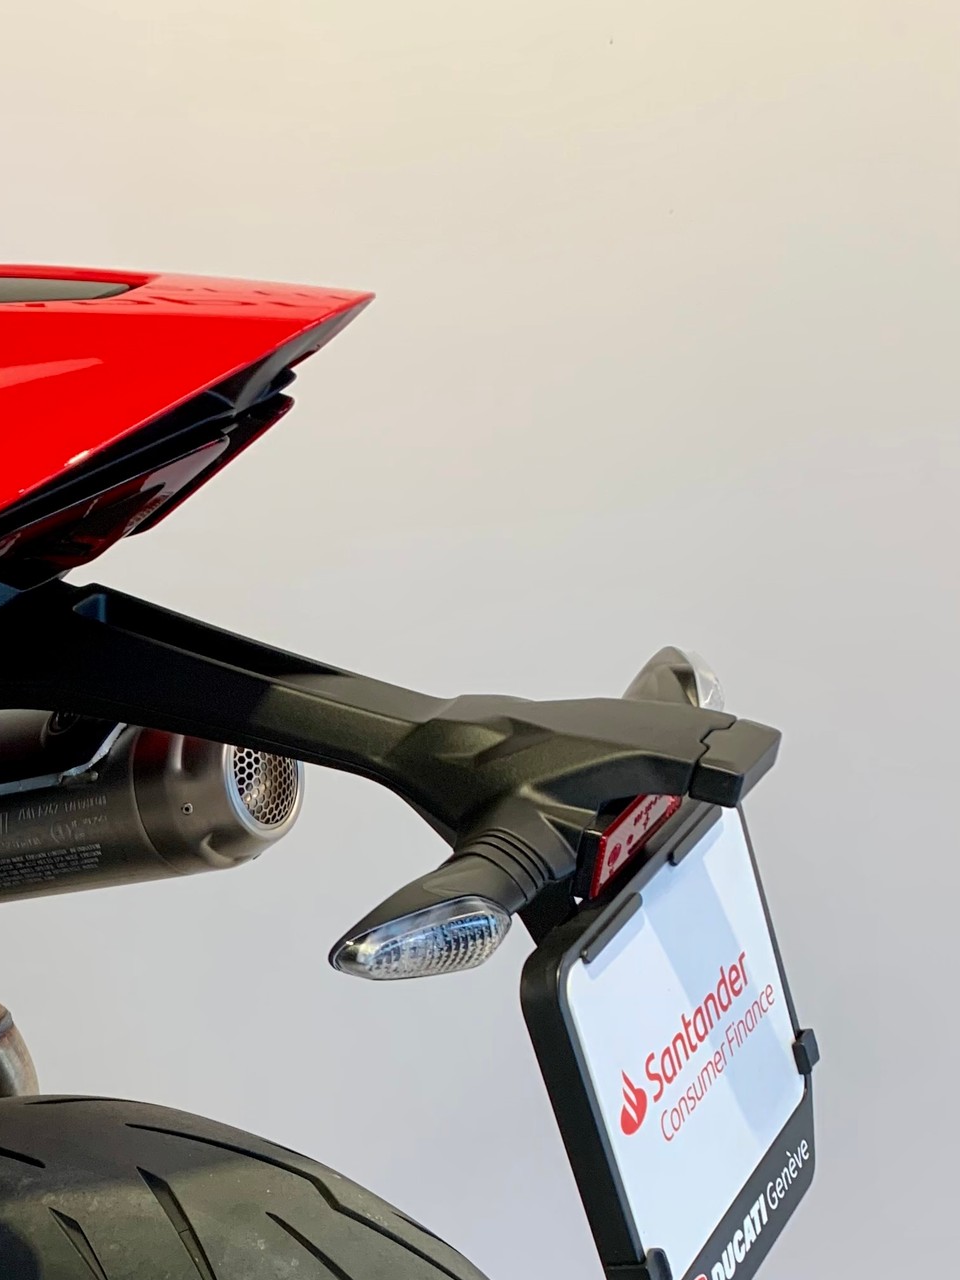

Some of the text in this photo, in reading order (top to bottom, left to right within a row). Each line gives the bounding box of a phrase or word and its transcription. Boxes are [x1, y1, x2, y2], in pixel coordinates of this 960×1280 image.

[645, 951, 748, 1103] Santander
[661, 984, 775, 1141] Consumer Finance
[766, 1139, 809, 1210] Genève
